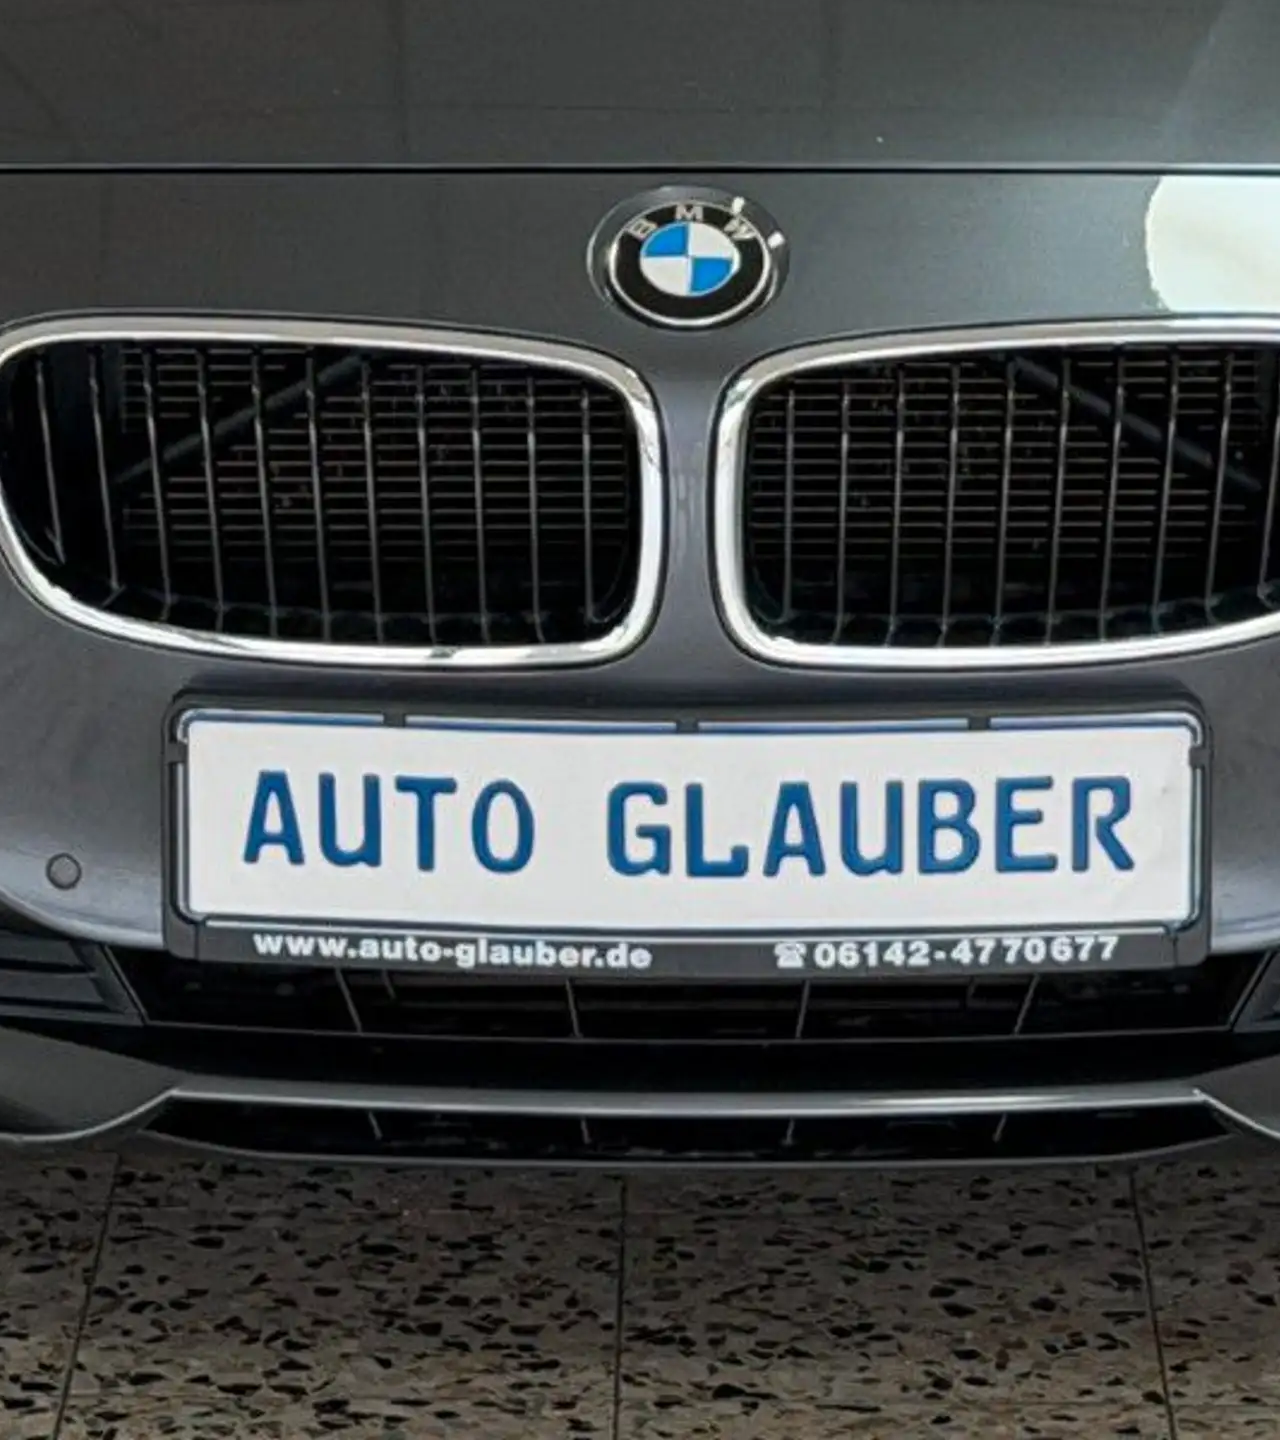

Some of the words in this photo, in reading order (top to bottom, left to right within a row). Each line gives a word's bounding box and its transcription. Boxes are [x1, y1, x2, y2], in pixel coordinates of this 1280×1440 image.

[623, 203, 758, 242] BMW
[242, 769, 536, 875] AUTO
[605, 774, 1136, 879] GLAUBER
[252, 931, 654, 971] www.auto-glauber.de
[814, 935, 1119, 969] 06142-4770677
